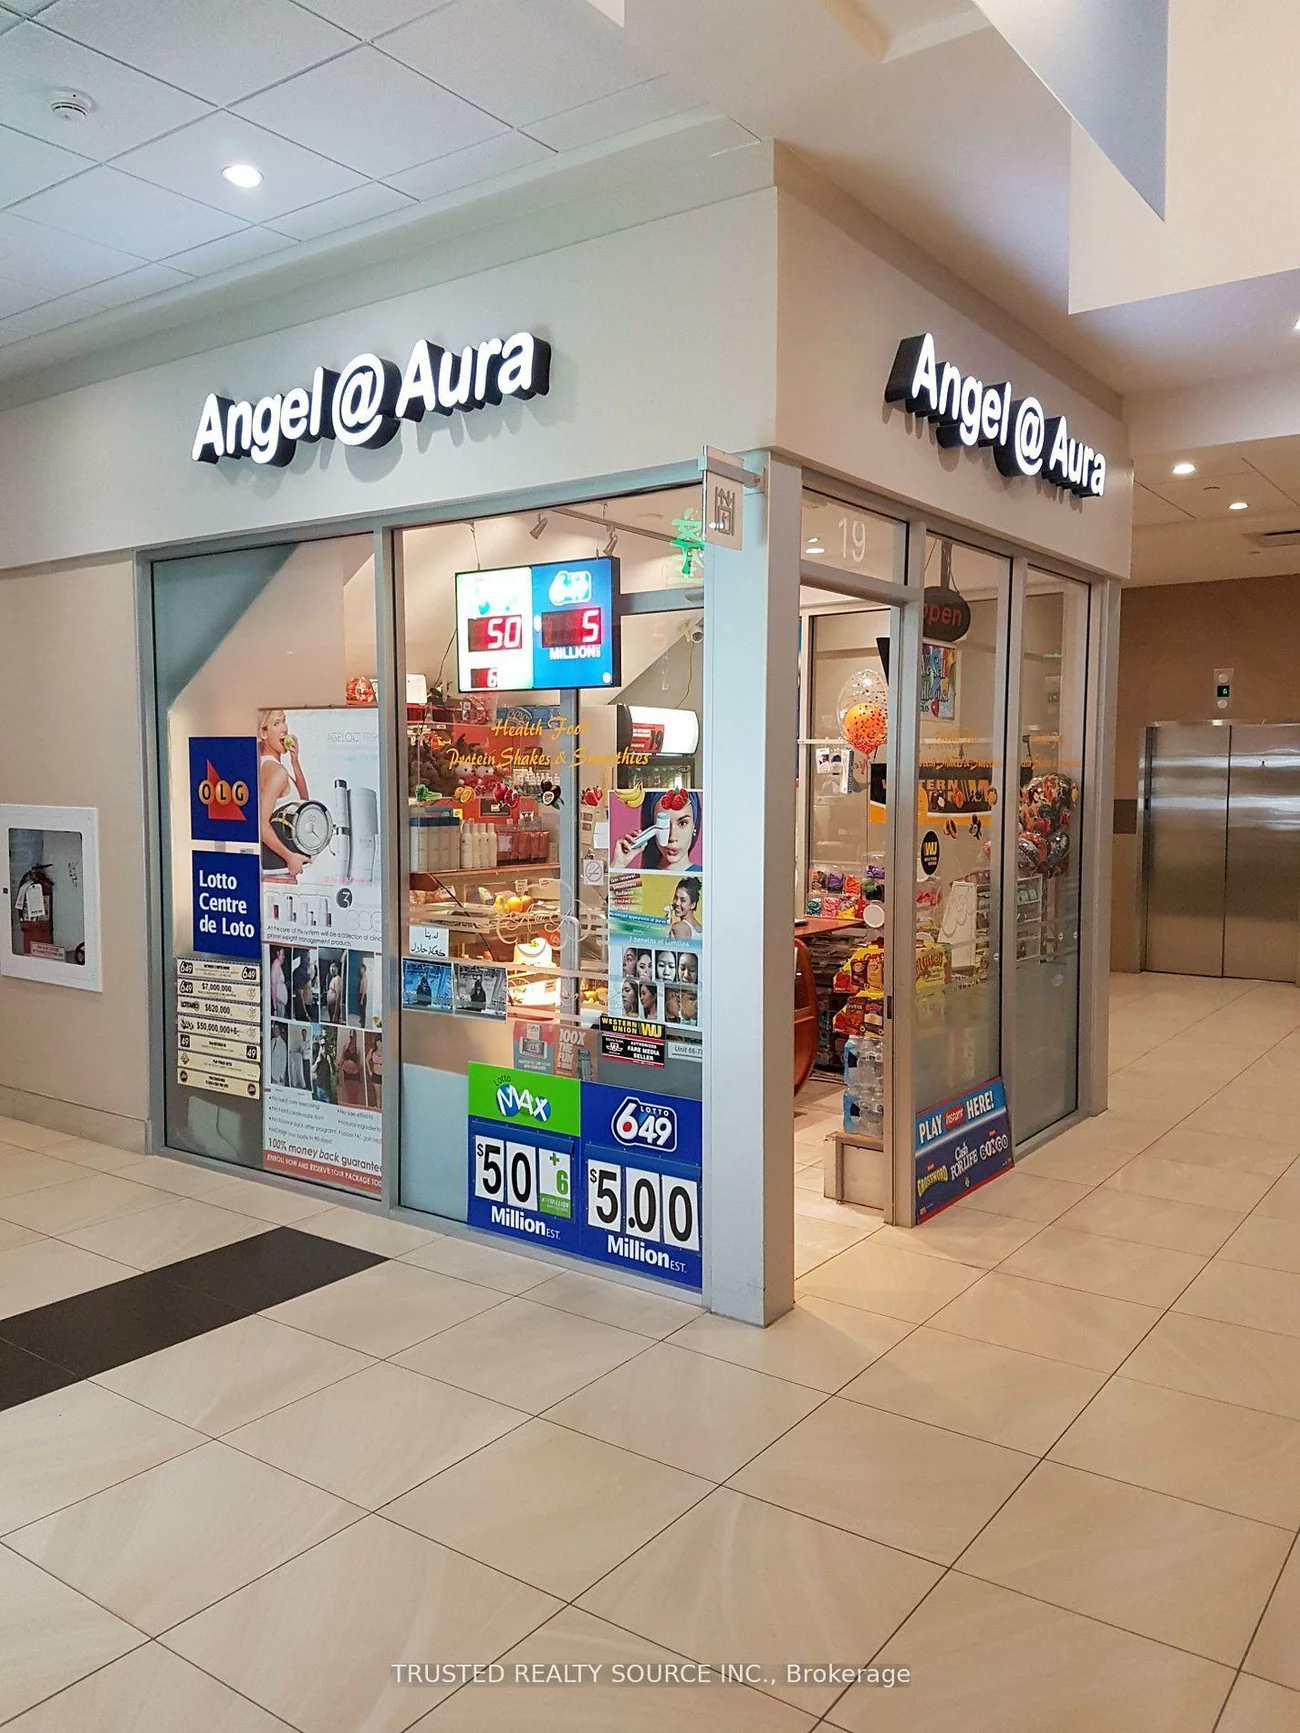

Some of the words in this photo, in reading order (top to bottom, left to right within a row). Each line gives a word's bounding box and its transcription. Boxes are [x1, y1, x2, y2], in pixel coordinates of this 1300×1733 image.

[192, 366, 324, 465] Angel
[332, 353, 384, 446] @
[396, 332, 536, 418] Aura
[912, 332, 1012, 446] Angel
[1015, 396, 1045, 476] @
[1049, 416, 1106, 496] Aura
[838, 516, 866, 563] 19
[486, 616, 522, 650] 50
[582, 610, 600, 642] 5
[491, 718, 544, 736] Health
[446, 748, 497, 770] Protein
[497, 748, 551, 768] Shakes
[555, 752, 567, 764] &
[200, 782, 245, 802] OLG
[924, 842, 938, 856] WU
[199, 870, 238, 890] Lotto
[199, 893, 248, 914] Centre
[200, 916, 216, 933] de
[222, 918, 255, 938] Loto
[242, 967, 256, 980] 649
[202, 982, 232, 993] $7,000,000
[602, 1017, 638, 1028] WESTERN
[612, 1025, 638, 1034] UNION
[641, 1022, 662, 1038] WU
[180, 1037, 190, 1048] 49
[558, 1028, 586, 1046] 100X
[246, 1048, 256, 1060] 49
[558, 1043, 574, 1053] THE
[558, 1052, 574, 1064] FUN
[633, 1053, 654, 1062] SELLER
[642, 1048, 660, 1056] MEDIA
[674, 1045, 686, 1053] Unit
[496, 1084, 548, 1122] MAX
[640, 1105, 669, 1116] LOTTO
[918, 1114, 943, 1144] PLAY
[966, 1090, 994, 1120] HERE!
[268, 1137, 286, 1150] 100%
[288, 1143, 318, 1159] money
[318, 1148, 338, 1161] back
[954, 1140, 968, 1160] Cash
[266, 1153, 284, 1164] ENROLL
[285, 1158, 296, 1166] NOW
[298, 1161, 308, 1169] AND
[310, 1163, 329, 1174] RESERVE
[345, 1171, 370, 1185] PACKAGE
[476, 1144, 532, 1203] $50
[556, 1170, 569, 1196] 6
[950, 1160, 964, 1182] FOR
[963, 1150, 978, 1172] LIFE
[917, 1164, 948, 1198] CROSSWORD
[590, 1168, 692, 1242] $5.00
[491, 1206, 546, 1236] Million
[546, 1228, 561, 1241] EST.
[607, 1235, 670, 1269] Million
[670, 1260, 687, 1274] EST.
